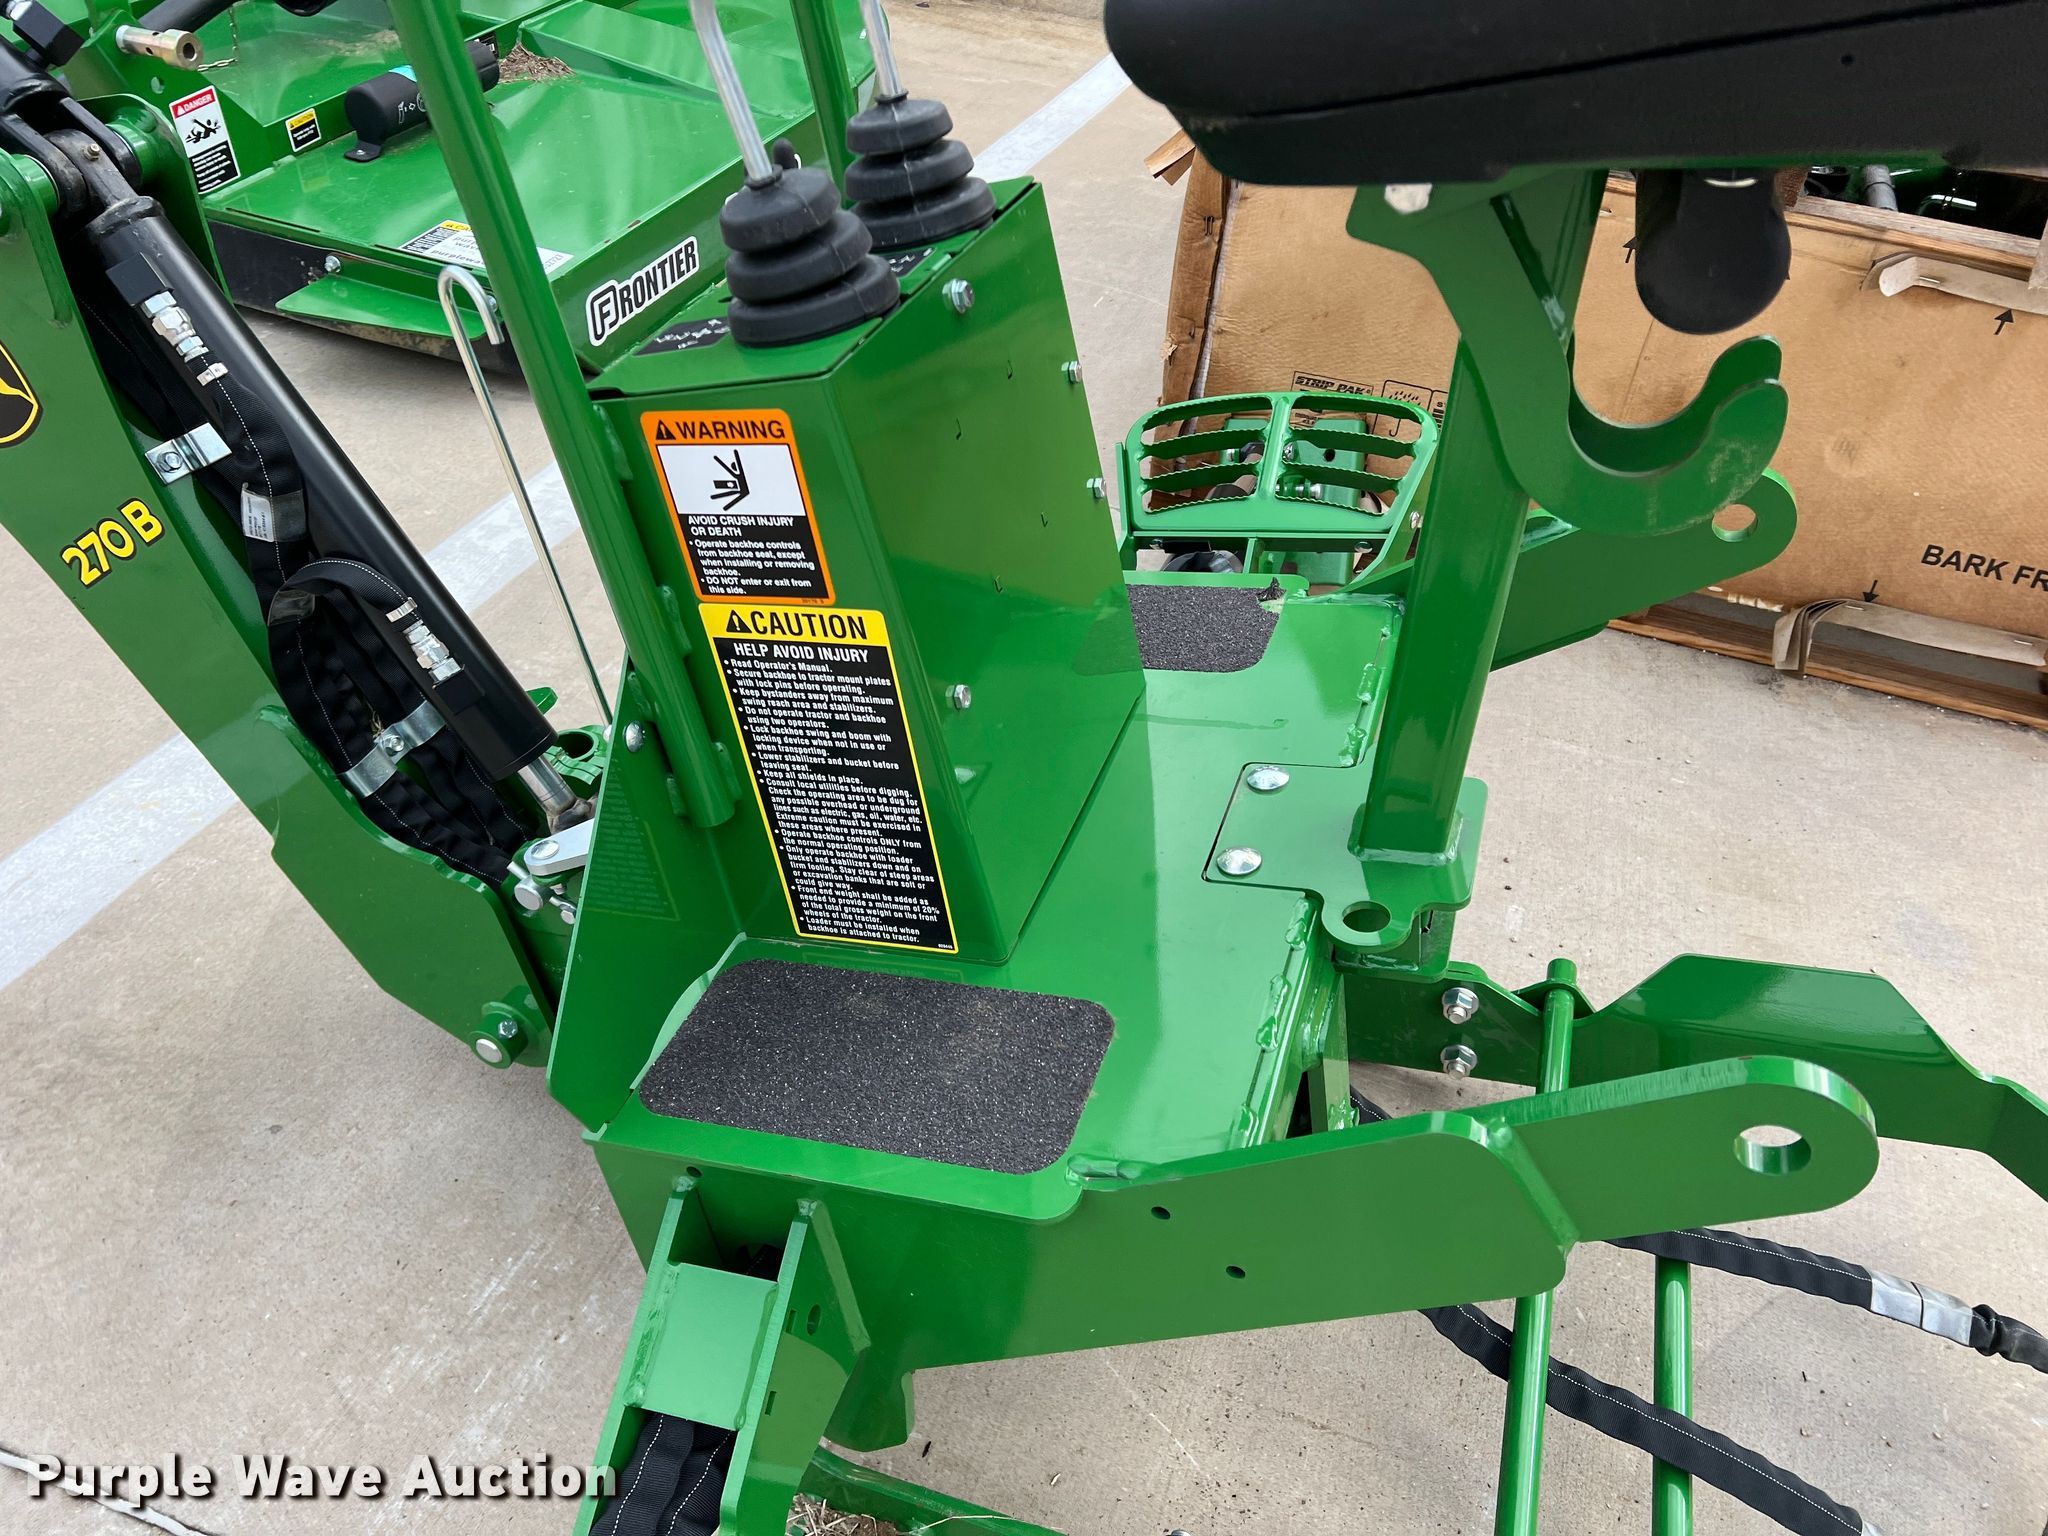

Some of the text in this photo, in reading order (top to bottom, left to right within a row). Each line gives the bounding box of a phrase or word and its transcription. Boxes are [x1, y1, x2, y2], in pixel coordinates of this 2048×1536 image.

[183, 94, 212, 111] DANGER
[591, 241, 696, 340] FRONTIER
[1295, 376, 1335, 389] STRIP
[675, 420, 786, 439] WARNING
[688, 515, 794, 526] AVOID CRUSH INJURY
[690, 526, 742, 536] OR DEATH
[694, 539, 802, 549] Operate backhoe controls
[697, 548, 806, 561] from backhoe seat, except
[1921, 544, 2009, 581] BARK
[700, 558, 723, 566] when
[723, 558, 763, 569] installing
[774, 560, 815, 571] removing
[702, 567, 741, 576] backhoe.
[705, 576, 720, 585] DO
[720, 576, 739, 585] NOT
[740, 578, 762, 586] enter
[774, 578, 791, 587] exit
[791, 578, 812, 587] from
[708, 585, 747, 594] this side.
[750, 610, 868, 640] CAUTION
[733, 642, 868, 663] HELP AVOID INJURY
[730, 658, 833, 673] Read Operator's Manual.
[733, 668, 762, 678] Secure
[762, 670, 797, 680] backhoe
[807, 672, 835, 682] tractor
[837, 675, 864, 684] mount
[864, 676, 891, 686] plates
[736, 678, 866, 695] with lock pins before operating.
[739, 687, 894, 705] Keep bystanders away from maximum
[742, 697, 766, 708] swing
[767, 699, 791, 707] reach
[791, 701, 811, 709] area
[829, 702, 876, 713] stabilizers.
[747, 716, 770, 726] using
[787, 719, 829, 729] operators.
[772, 709, 804, 718] operate
[804, 710, 832, 719] tractor
[851, 713, 886, 724] backhoe
[750, 724, 770, 733] Lock
[770, 725, 804, 736] backhoe
[805, 729, 830, 739] swing
[848, 731, 872, 741] boom
[873, 733, 892, 742] with
[752, 733, 782, 744] locking
[783, 736, 810, 745] device
[811, 738, 833, 747] when
[755, 743, 830, 757] when transporting.
[758, 751, 782, 761] Lower
[784, 754, 826, 764] stabilizers
[843, 758, 872, 768] bucket
[872, 760, 899, 770] before
[760, 760, 812, 772] leaving seat.
[763, 769, 784, 779] Keep
[797, 772, 827, 781] shields
[838, 775, 863, 784] place.
[766, 778, 913, 798] Consult local utilities before digging.
[768, 786, 792, 796] Check
[808, 791, 846, 801] operating
[847, 794, 865, 802] area
[786, 797, 820, 807] possible
[821, 800, 858, 810] overhead
[869, 804, 921, 815] underground
[775, 812, 807, 822] Extreme
[809, 816, 838, 824] caution
[839, 818, 859, 826] must
[872, 822, 911, 831] exercised
[778, 820, 800, 829] these
[824, 825, 849, 834] where
[850, 828, 883, 837] present.
[781, 828, 922, 849] Operate backhoe controls ONLY from
[803, 909, 830, 918] wheels
[854, 914, 882, 923] tractor.
[805, 916, 831, 925] Loader
[833, 920, 852, 928] must
[864, 922, 898, 933] installed
[899, 927, 920, 935] when
[807, 924, 838, 934] backhoe
[849, 929, 881, 938] attached
[892, 933, 919, 943] tractor.
